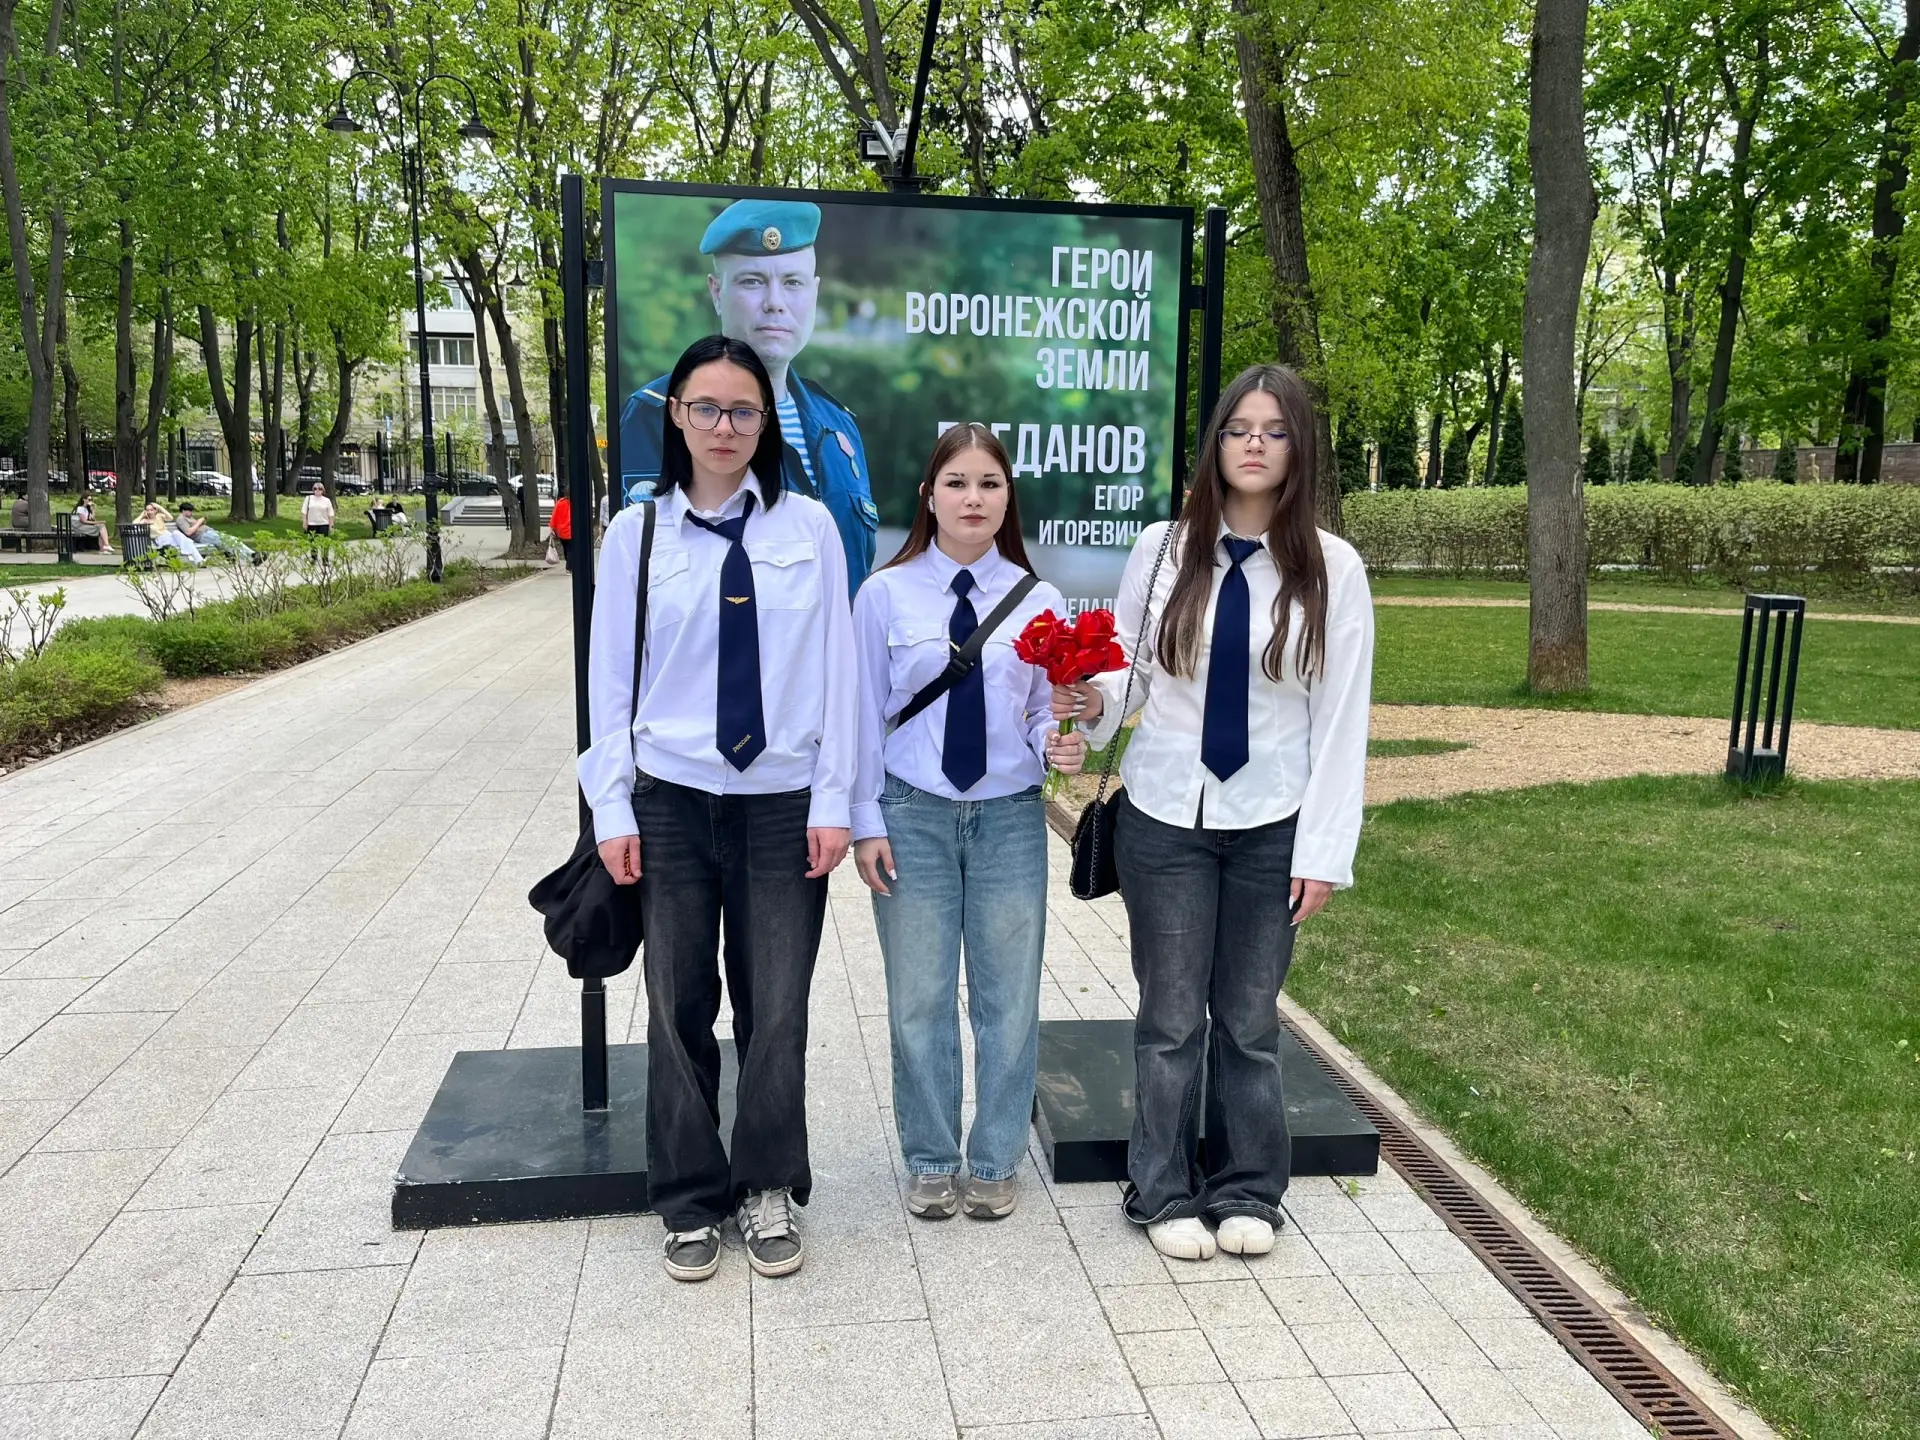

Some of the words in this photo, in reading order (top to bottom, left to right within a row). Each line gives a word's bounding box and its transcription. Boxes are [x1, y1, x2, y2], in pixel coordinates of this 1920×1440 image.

[1051, 246, 1153, 291] ГЕРОИ
[905, 290, 1151, 342] ВОРОНЕЖСКОЙ
[1036, 347, 1149, 391] ЗЕМЛИ
[938, 421, 1146, 479] ДАНОВ
[1094, 484, 1144, 511] ЕГОР
[1038, 519, 1142, 546] ИГОРЕВИЧ
[1064, 597, 1117, 619] ЕДАЛ
